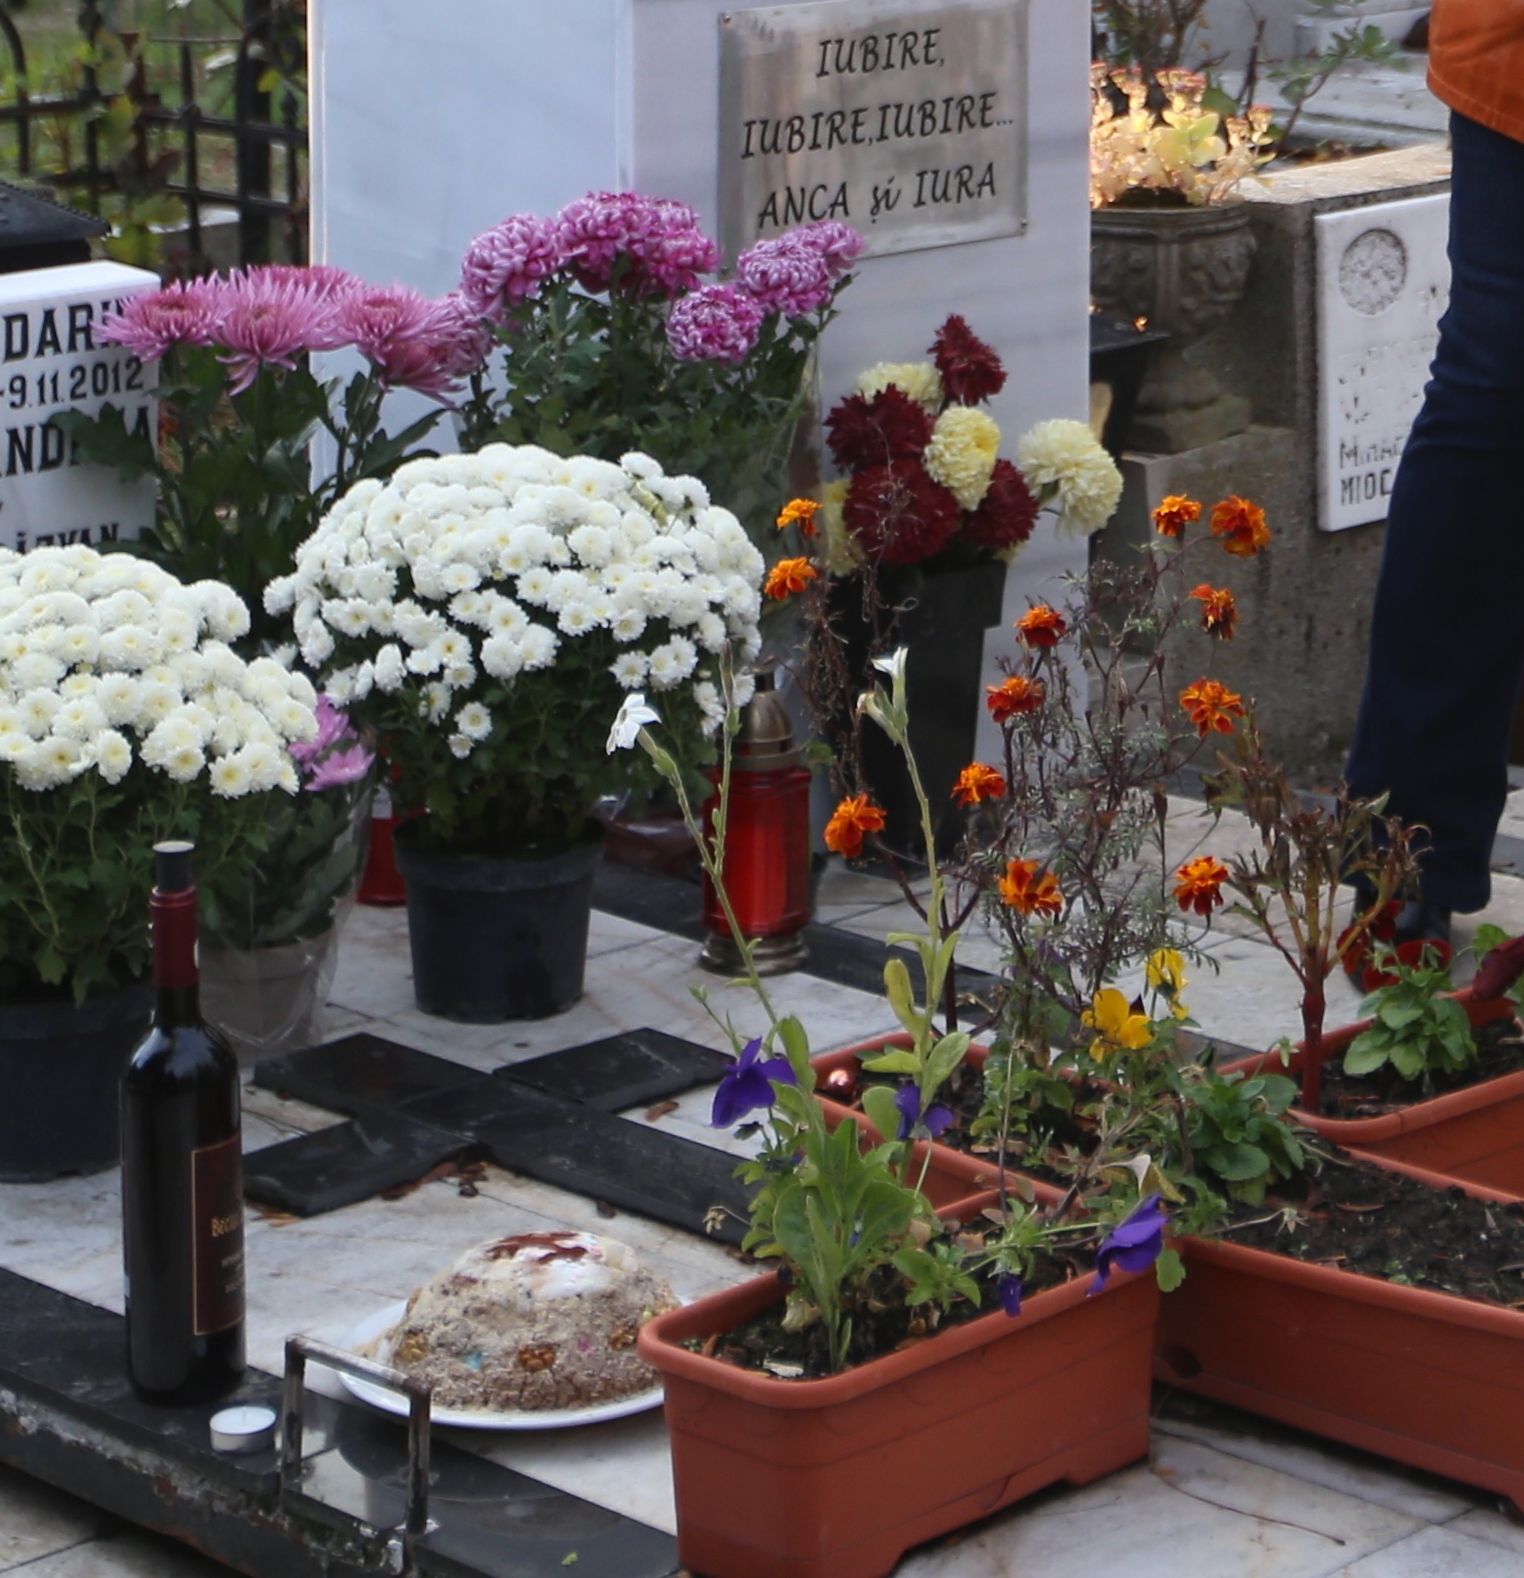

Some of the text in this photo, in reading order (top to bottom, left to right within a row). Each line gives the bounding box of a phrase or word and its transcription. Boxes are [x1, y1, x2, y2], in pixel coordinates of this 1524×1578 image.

[815, 28, 945, 78] IUBIRE,
[757, 182, 850, 230] ANCA
[912, 162, 997, 208] IURA
[1, 295, 135, 364] DARI
